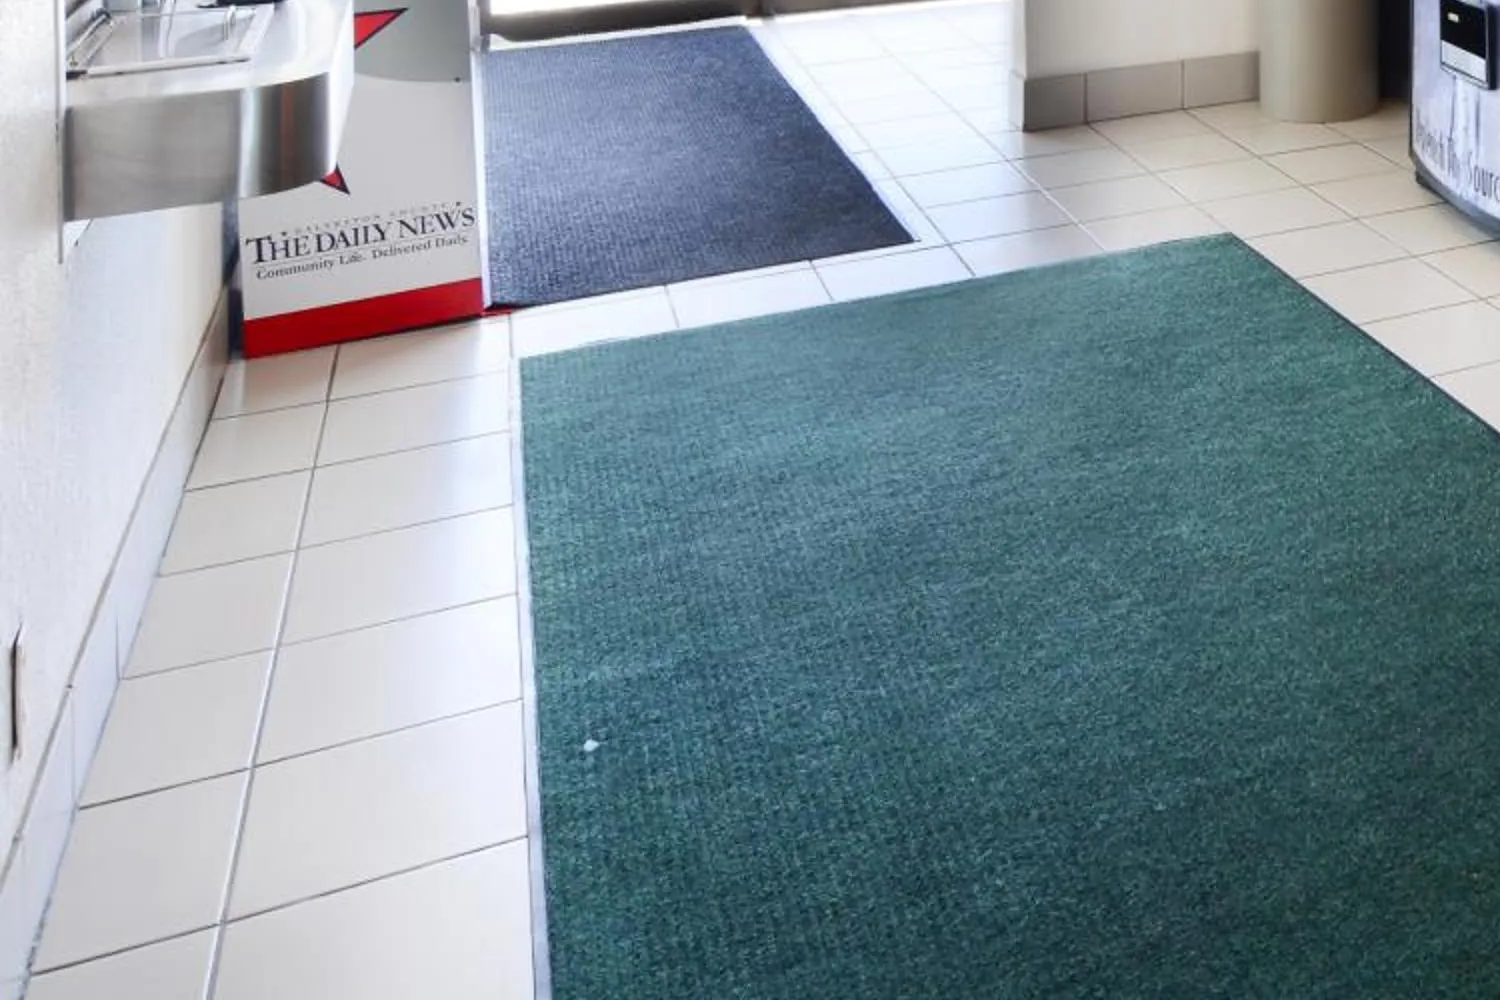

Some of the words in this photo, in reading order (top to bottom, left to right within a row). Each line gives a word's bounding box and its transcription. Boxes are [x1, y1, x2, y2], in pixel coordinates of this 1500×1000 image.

[245, 230, 310, 264] THE
[315, 222, 393, 253] DAILY
[399, 207, 476, 239] NEWS
[256, 256, 336, 281] Community
